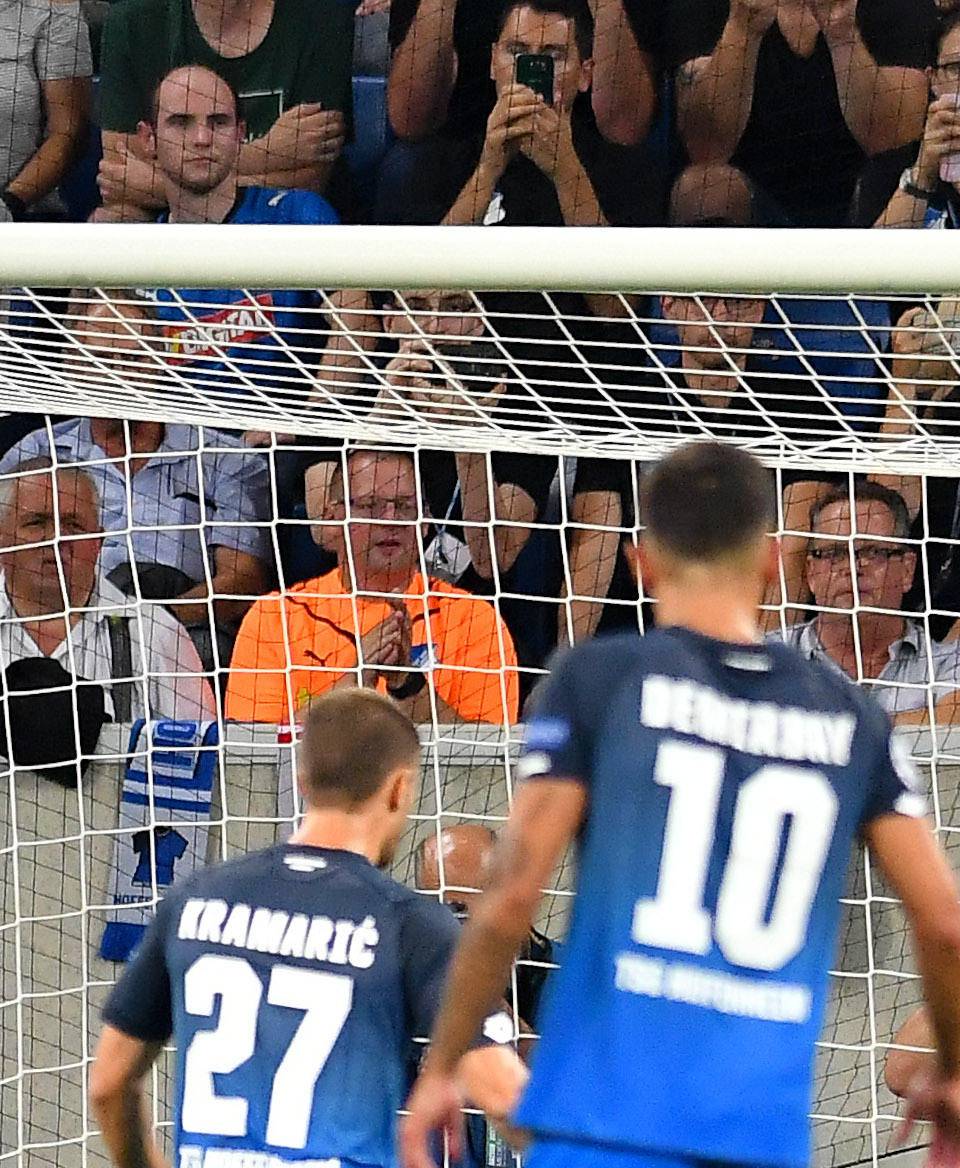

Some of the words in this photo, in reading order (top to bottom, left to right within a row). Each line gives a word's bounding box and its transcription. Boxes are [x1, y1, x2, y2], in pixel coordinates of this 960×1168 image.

[178, 897, 380, 970] KRAMARIĆ
[630, 737, 841, 972] 10
[182, 952, 355, 1150] 27
